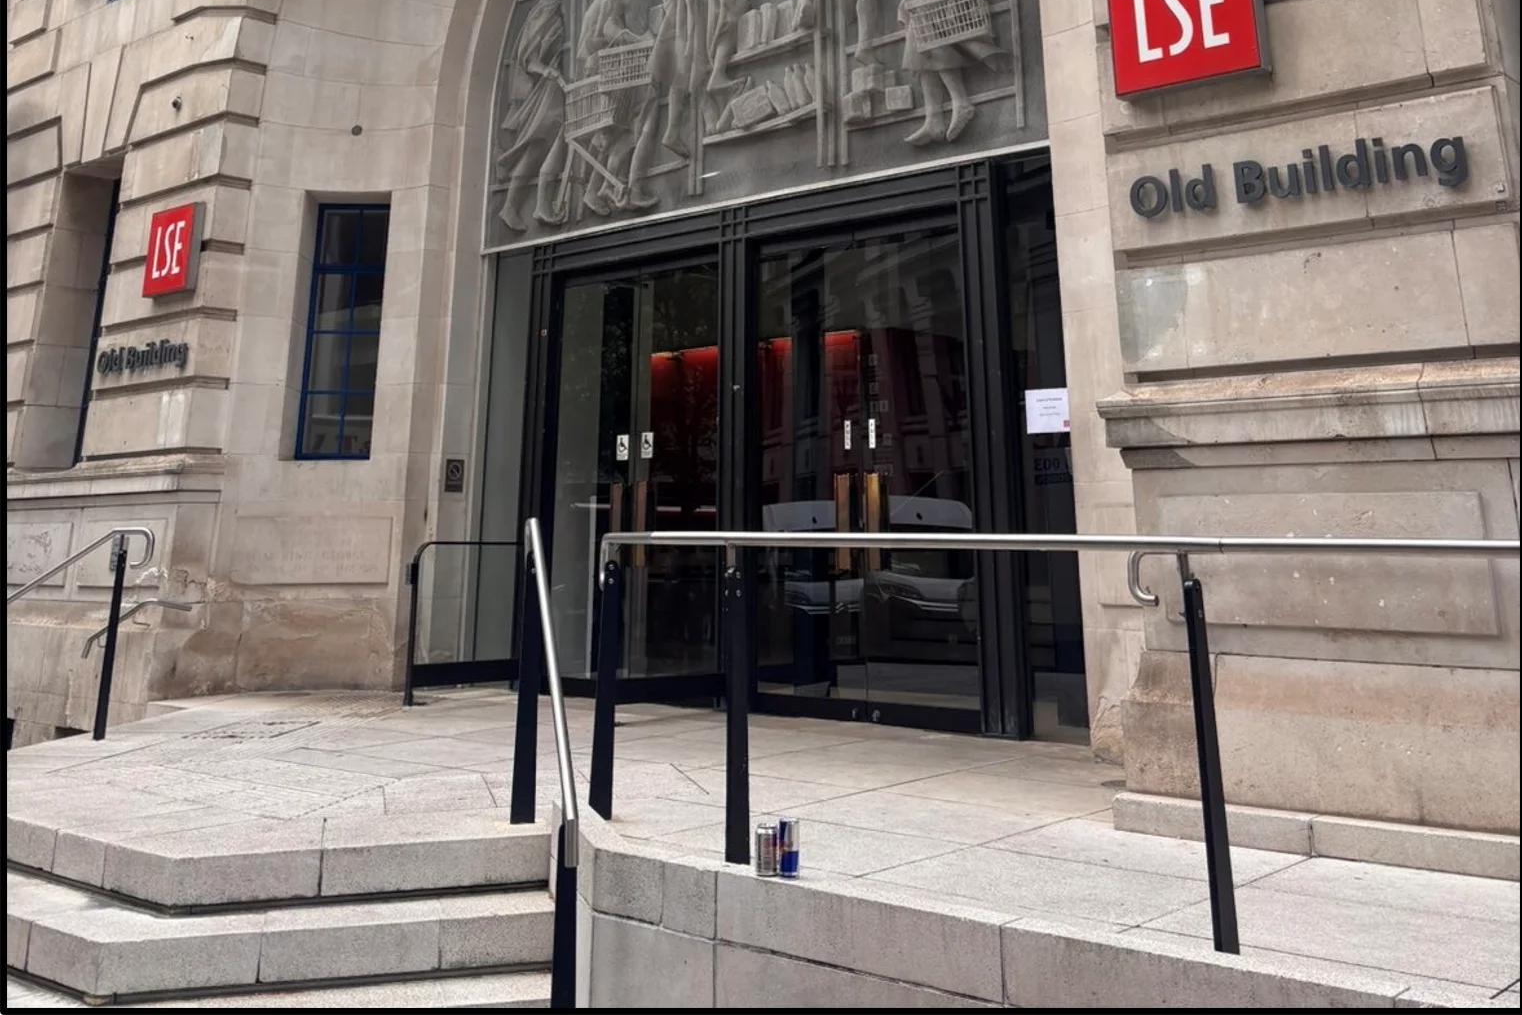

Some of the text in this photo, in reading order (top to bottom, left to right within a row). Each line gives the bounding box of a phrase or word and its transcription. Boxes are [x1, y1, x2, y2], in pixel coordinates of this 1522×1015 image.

[1130, 135, 1469, 220] Old Building
[152, 220, 186, 280] LSE
[97, 339, 189, 375] Old Building
